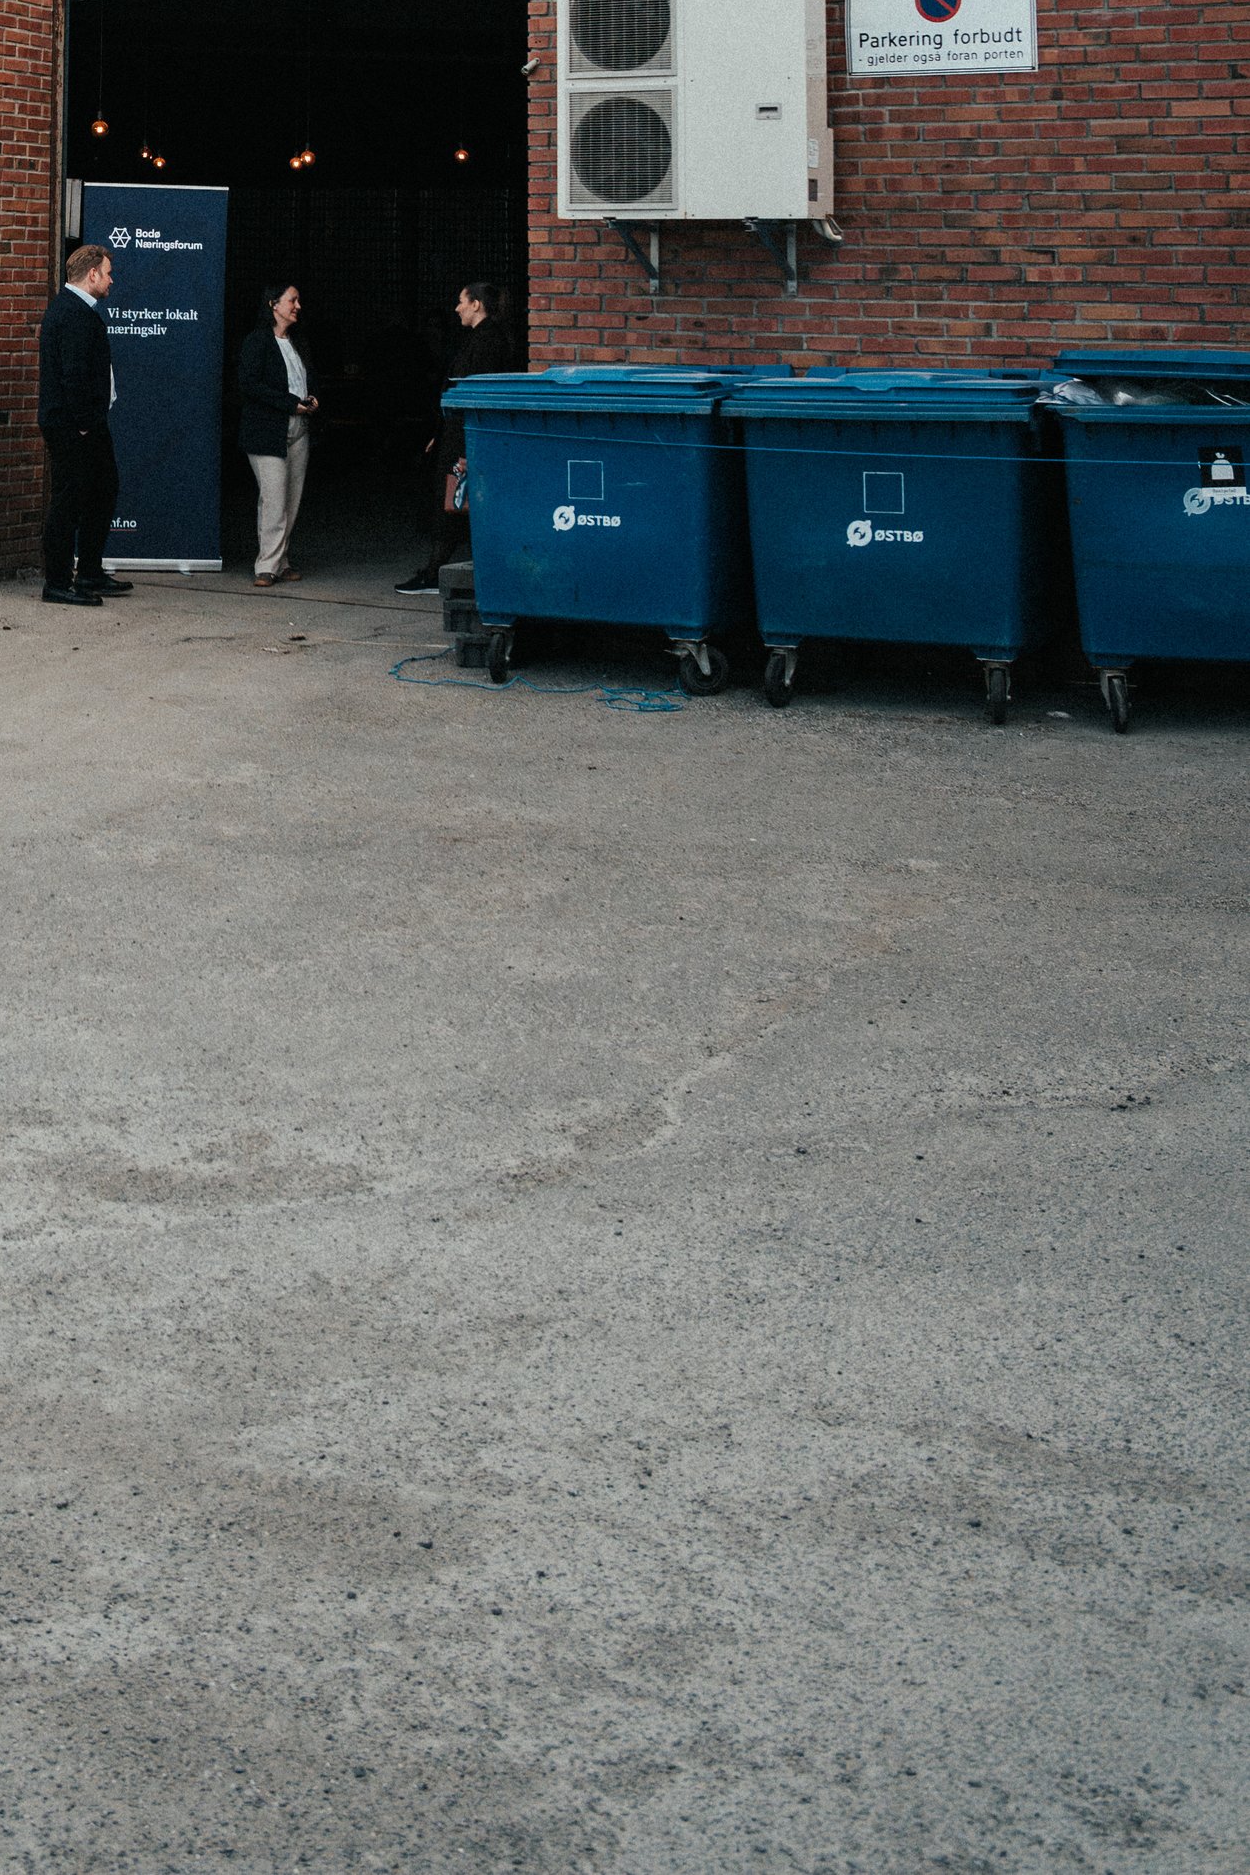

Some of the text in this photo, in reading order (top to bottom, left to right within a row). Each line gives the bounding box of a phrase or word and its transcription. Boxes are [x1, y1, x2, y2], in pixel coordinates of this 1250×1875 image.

[859, 27, 1023, 50] Parkering forbudt
[867, 52, 909, 66] gjelder
[913, 50, 941, 65] også
[947, 50, 978, 62] foran
[984, 49, 1024, 62] porten
[135, 228, 161, 239] Bodø
[135, 238, 203, 252] Næringsforum
[107, 307, 199, 322] Vi styrker lokalt
[106, 323, 167, 338] næringsliv
[1213, 491, 1250, 506] ØSTB
[110, 516, 137, 528] nf.no
[577, 514, 622, 527] ØSTBØ
[874, 529, 924, 543] ØSTBØ
